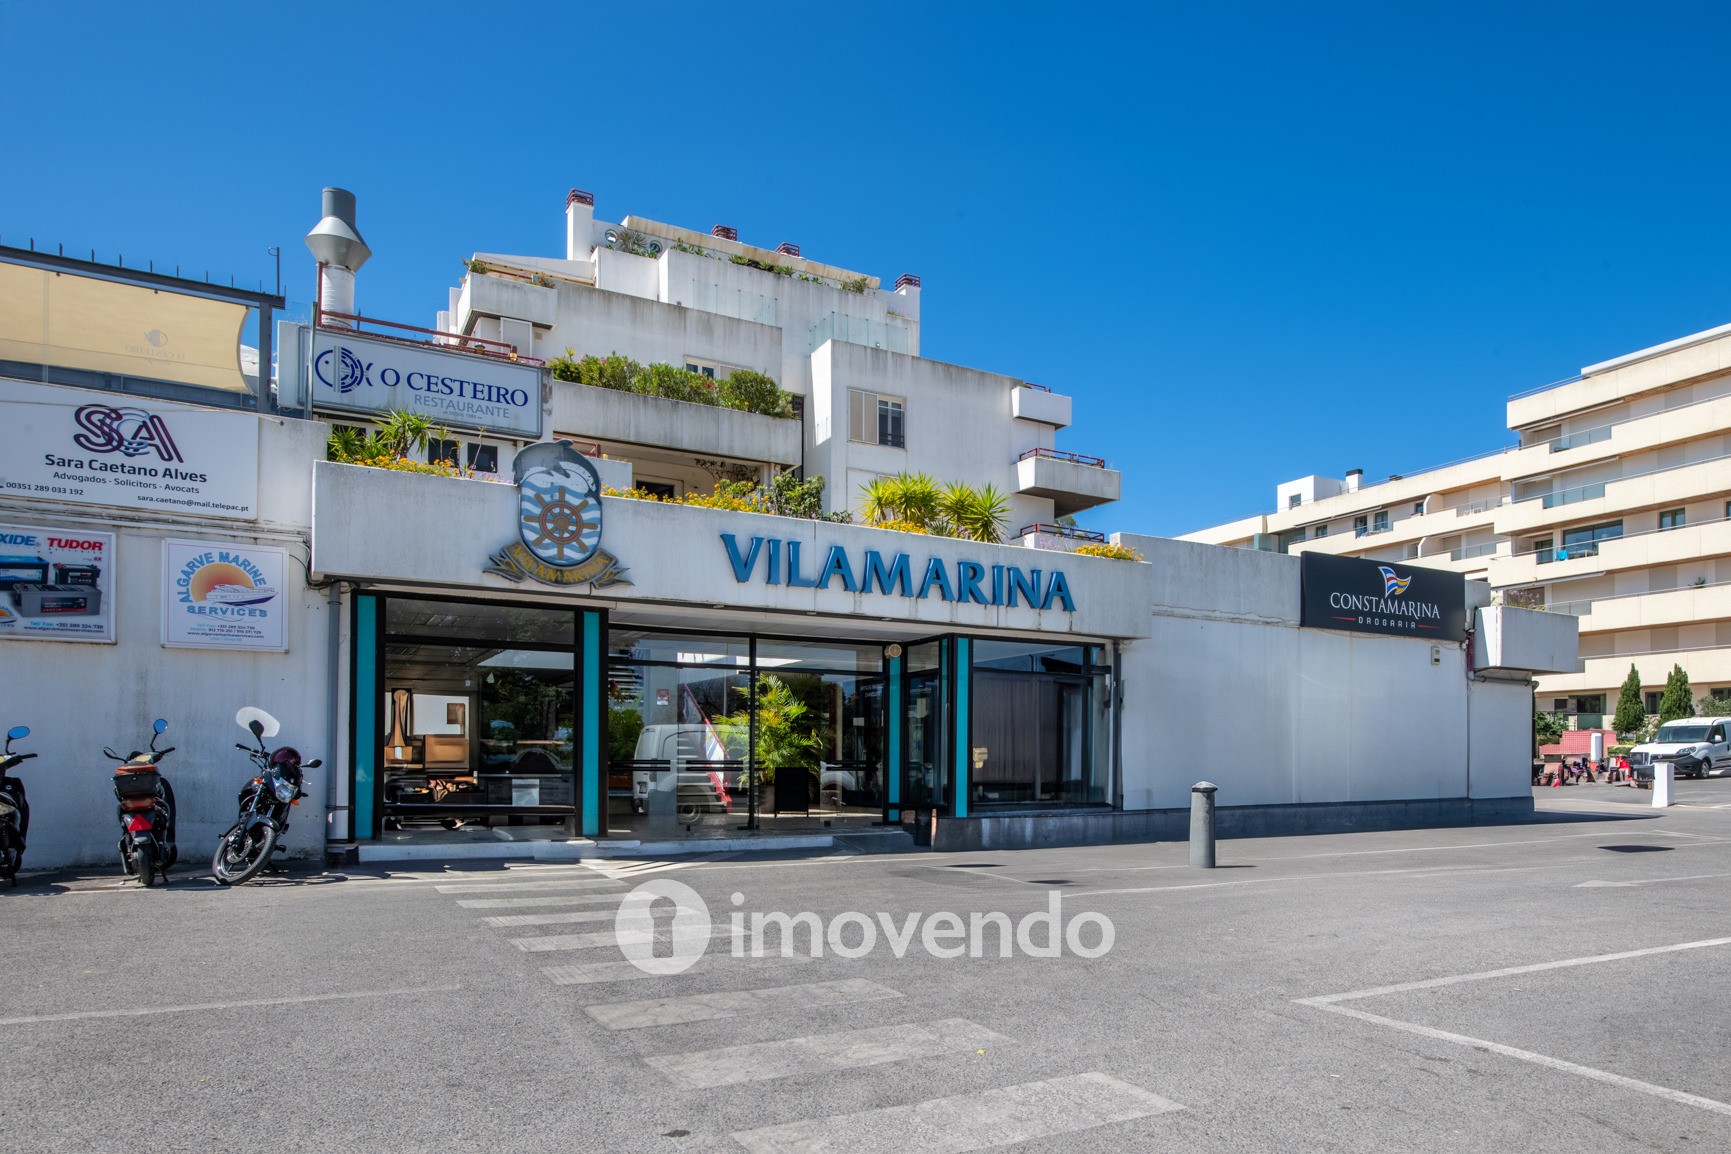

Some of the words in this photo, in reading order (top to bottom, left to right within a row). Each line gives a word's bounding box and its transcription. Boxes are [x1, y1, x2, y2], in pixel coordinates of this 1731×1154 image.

[380, 367, 401, 387] O
[406, 371, 529, 407] CESTEIRO
[414, 394, 510, 419] RESTAURANTE
[44, 453, 84, 470] Sara
[88, 458, 158, 478] Caetano
[162, 467, 208, 483] Alves
[6, 481, 32, 490] 00351
[34, 484, 50, 492] 289
[51, 486, 67, 494] 033
[68, 487, 84, 496] 192
[53, 471, 107, 485] Advogados
[114, 476, 157, 490] Solicitors
[164, 483, 200, 494] Avocats
[137, 494, 249, 512] sara.caetano@mail.telepac.pt
[0, 533, 36, 546] XIDE
[47, 537, 103, 551] TUDOR
[177, 551, 216, 603] ALGARVE
[218, 551, 267, 588] MARINE
[513, 546, 609, 583] VILAMARINA
[720, 533, 1077, 612] VILAMARINA
[187, 605, 267, 618] SERVICES
[1330, 592, 1441, 619] CONSTAMARINA
[1358, 616, 1416, 629] DROGARIA
